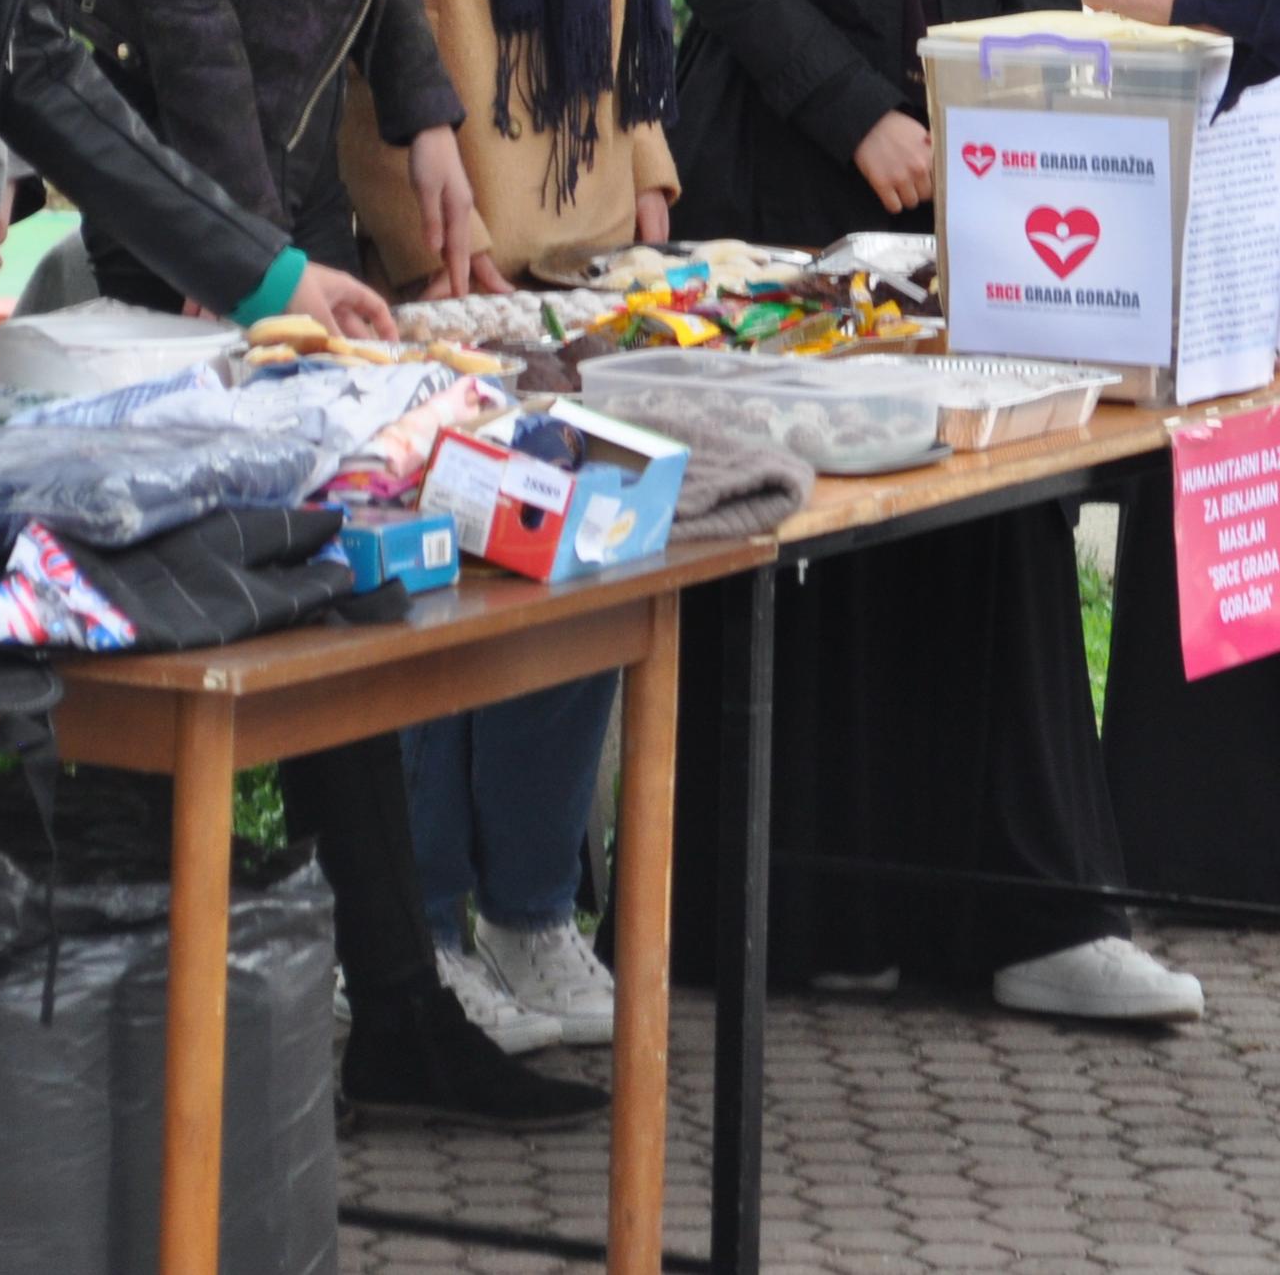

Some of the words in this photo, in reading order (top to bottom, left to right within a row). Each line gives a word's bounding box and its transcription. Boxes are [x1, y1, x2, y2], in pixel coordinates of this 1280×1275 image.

[1001, 150, 1037, 169] SRCE
[1040, 152, 1088, 171] GRADA
[1091, 155, 1156, 176] GORAŽDA
[986, 282, 1021, 302] SRCE
[1024, 284, 1072, 305] GRADA
[1075, 287, 1141, 309] GORAŽDA
[1182, 452, 1259, 496] HUMANITARNI
[1203, 497, 1220, 524] ZA
[1221, 481, 1279, 519] BENJAMIN
[1219, 517, 1266, 555] MASLAN
[1241, 548, 1280, 582] GRADA
